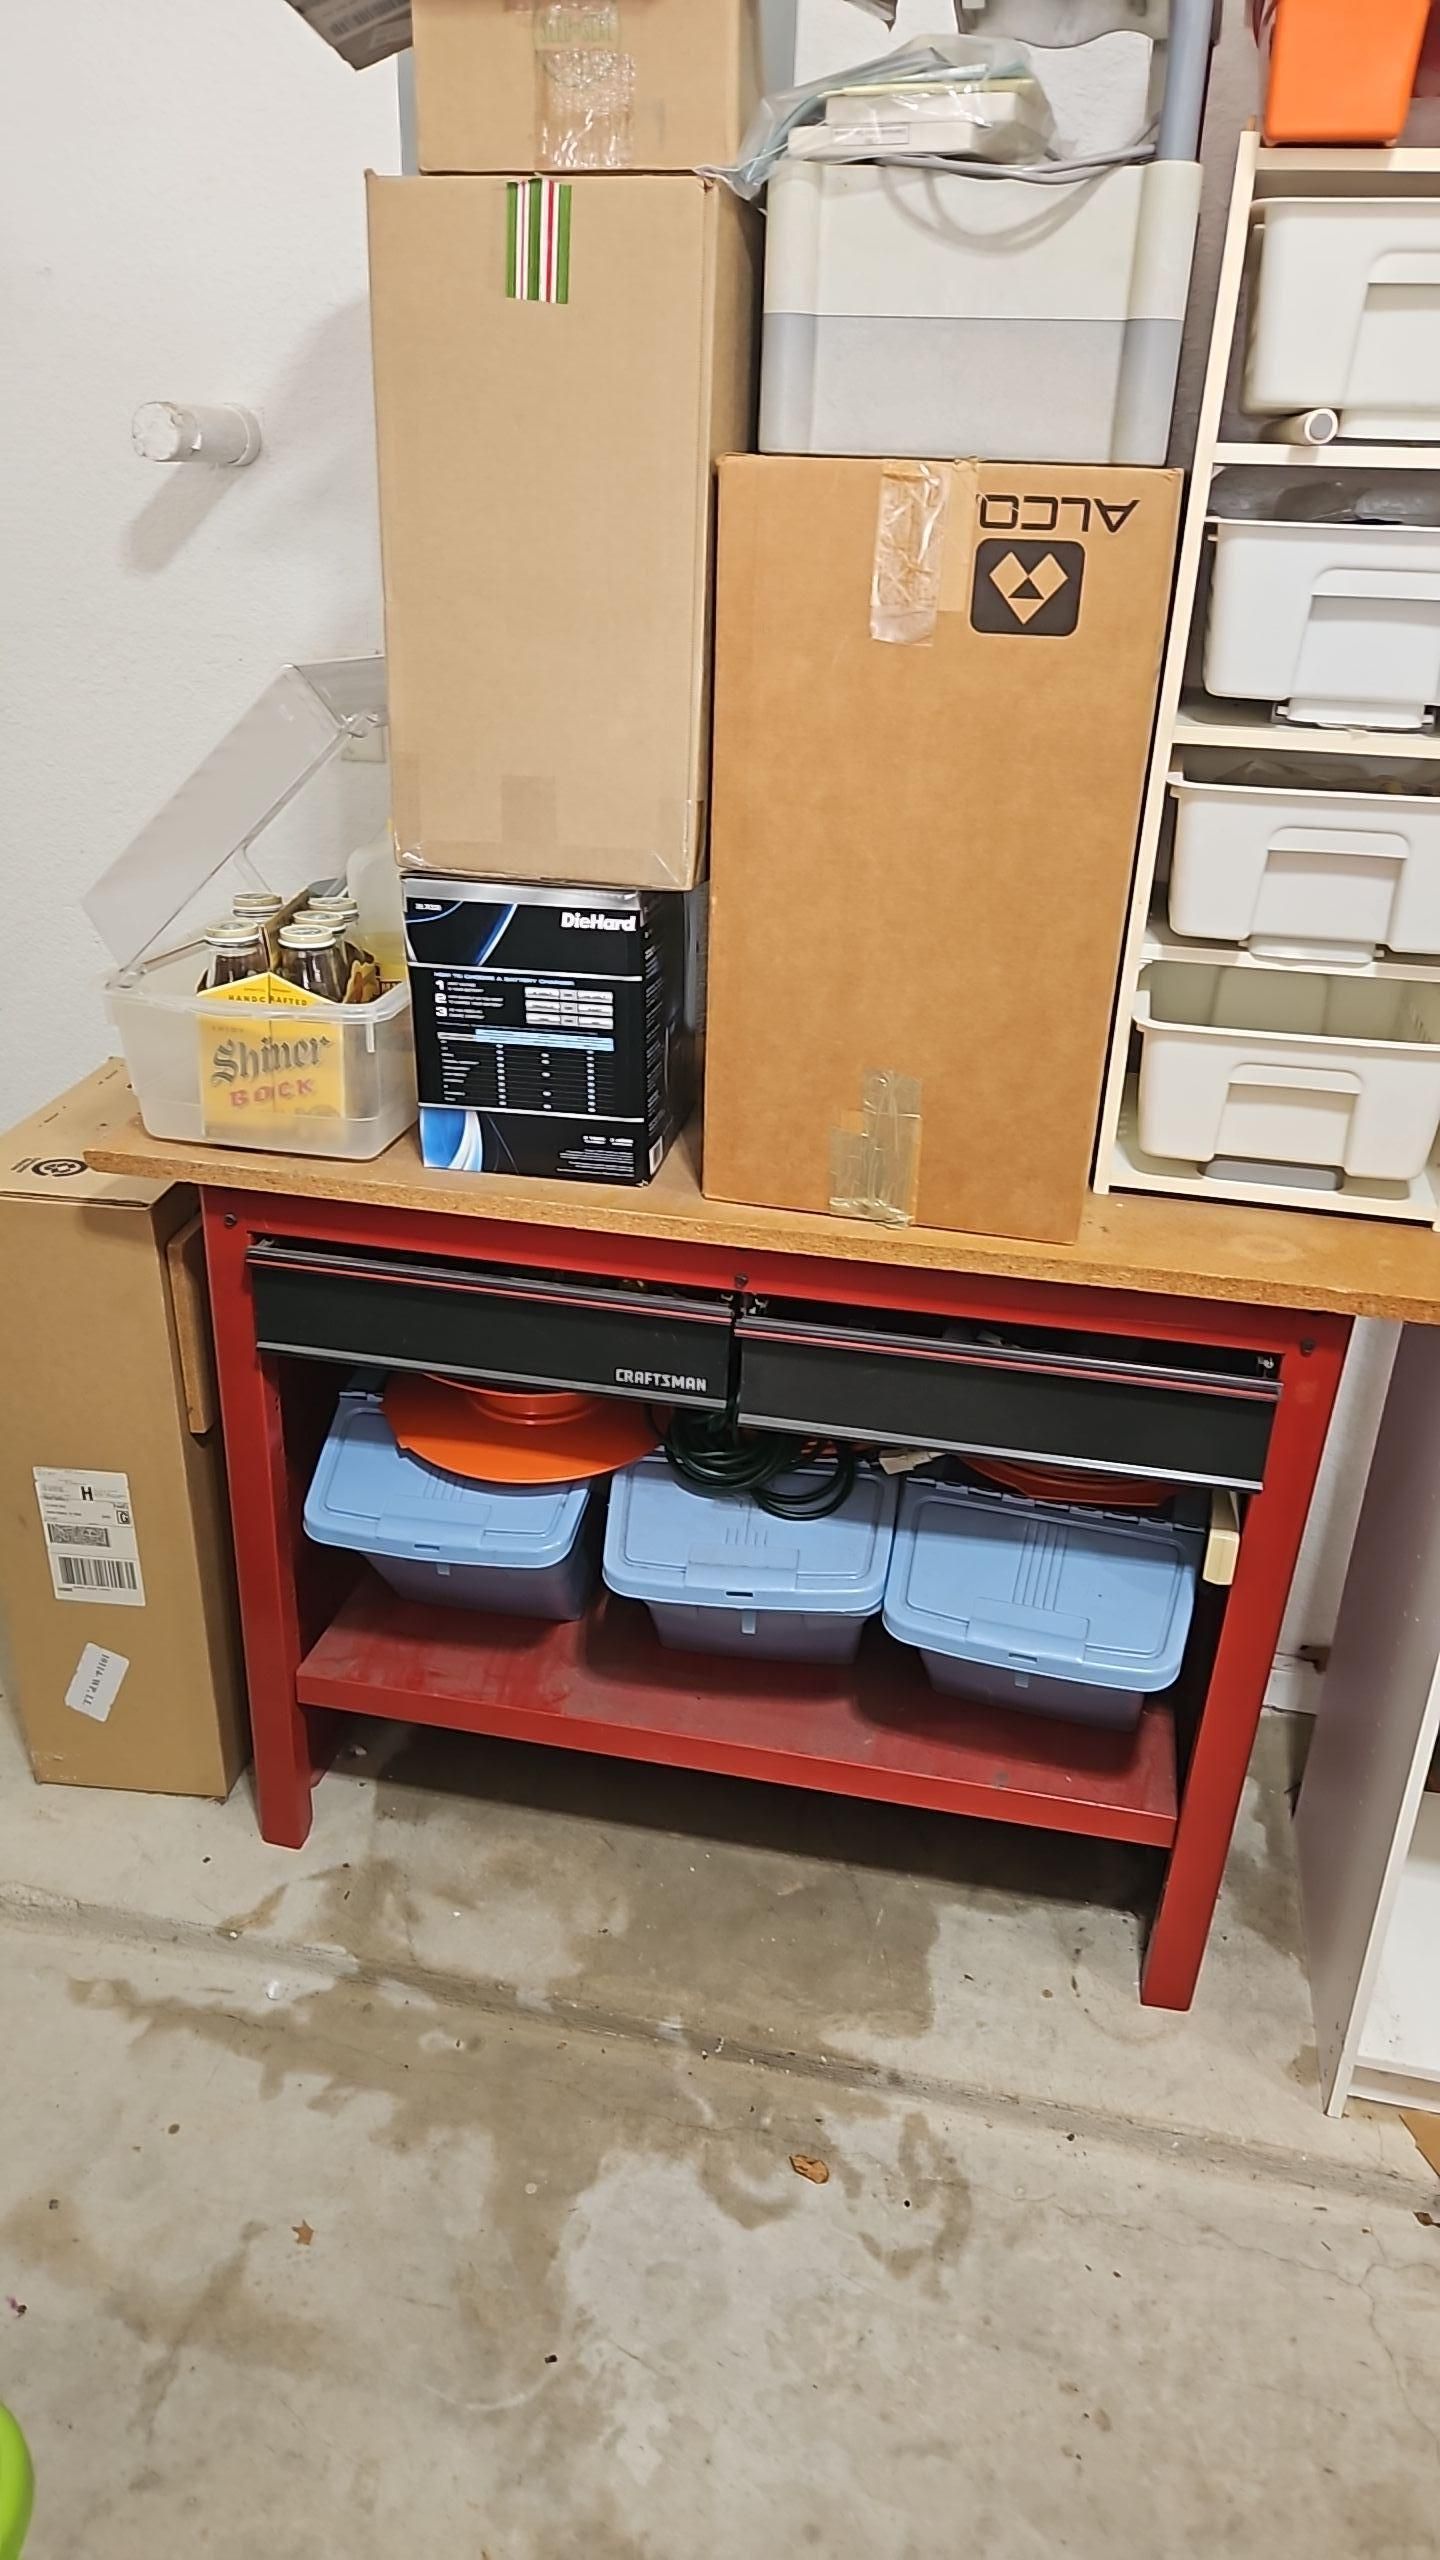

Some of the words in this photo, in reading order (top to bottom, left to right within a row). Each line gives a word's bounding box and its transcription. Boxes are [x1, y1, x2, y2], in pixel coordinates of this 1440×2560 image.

[978, 494, 1141, 533] ALCO
[561, 911, 637, 932] DieHard
[435, 980, 445, 991] 1
[228, 994, 308, 1006] HANDCRAFTED
[434, 992, 447, 1004] 2
[435, 1006, 448, 1017] 3
[211, 1035, 332, 1087] Shiner
[230, 1078, 314, 1107] BOCK
[615, 1368, 707, 1392] CRAFTSMAN
[80, 1486, 94, 1501] H
